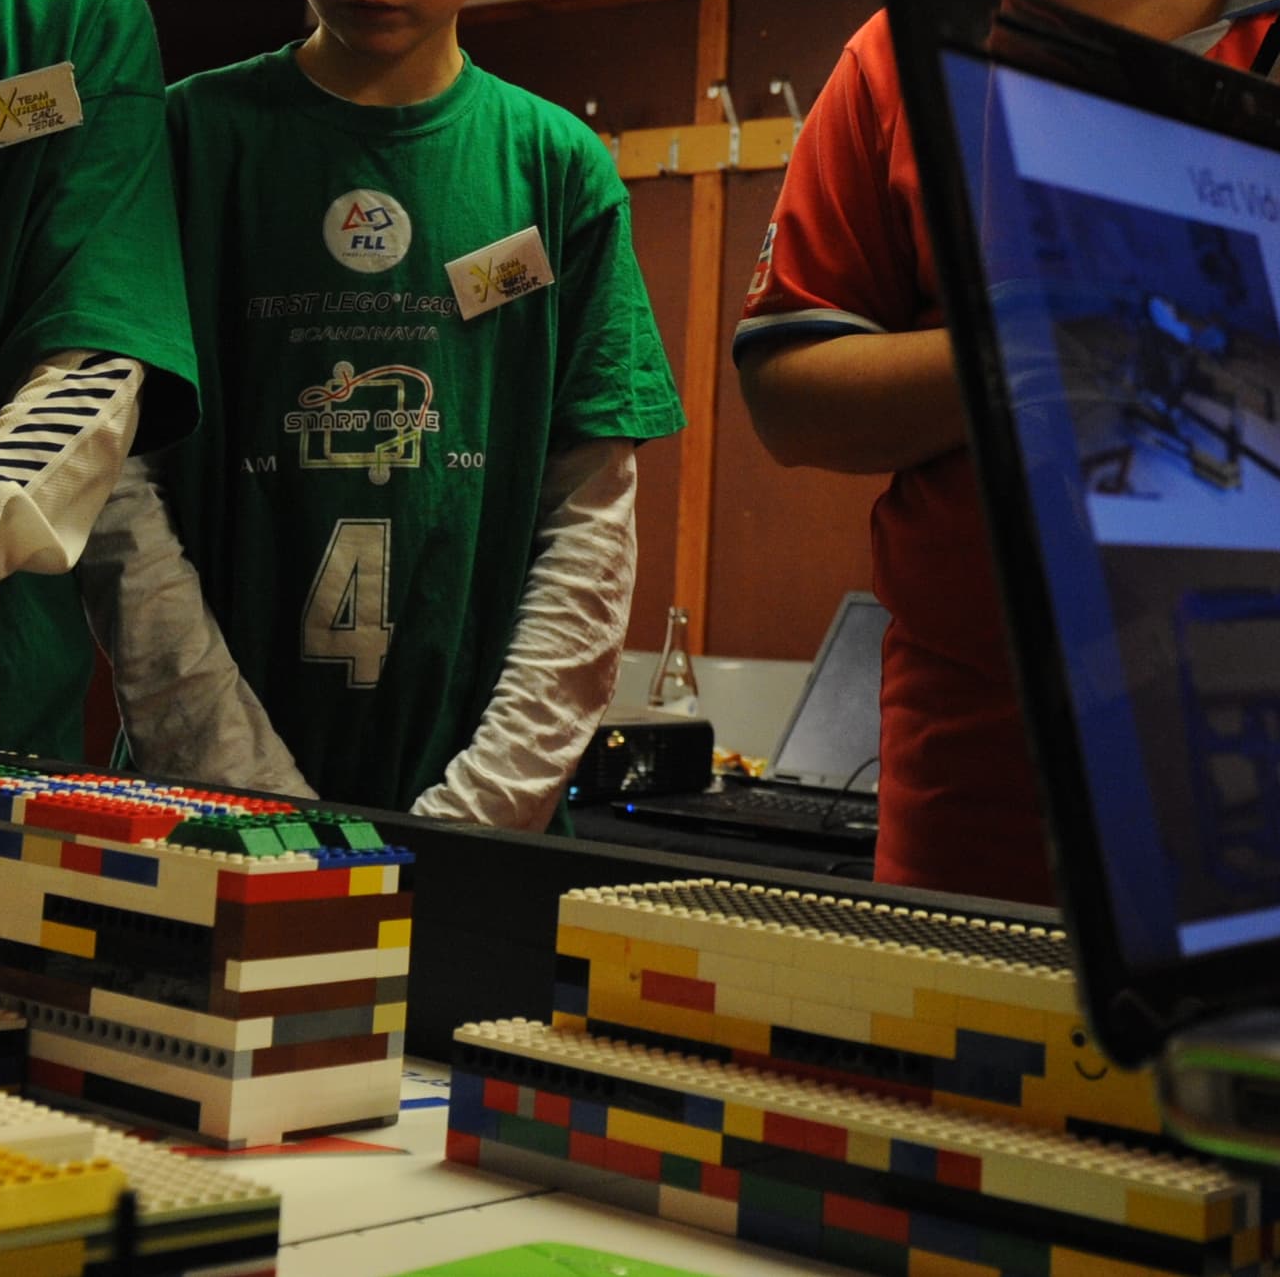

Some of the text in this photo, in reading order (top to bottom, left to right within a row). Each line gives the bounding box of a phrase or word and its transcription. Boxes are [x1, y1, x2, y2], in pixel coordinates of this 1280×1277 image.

[16, 89, 49, 105] TEAM
[350, 235, 386, 250] FLL
[245, 293, 321, 319] FIRST
[402, 292, 460, 318] Leag
[288, 324, 441, 344] SCANDINAVIA
[284, 410, 440, 433] SMART MOVE
[239, 451, 488, 475] AM 200
[299, 517, 396, 689] 4
